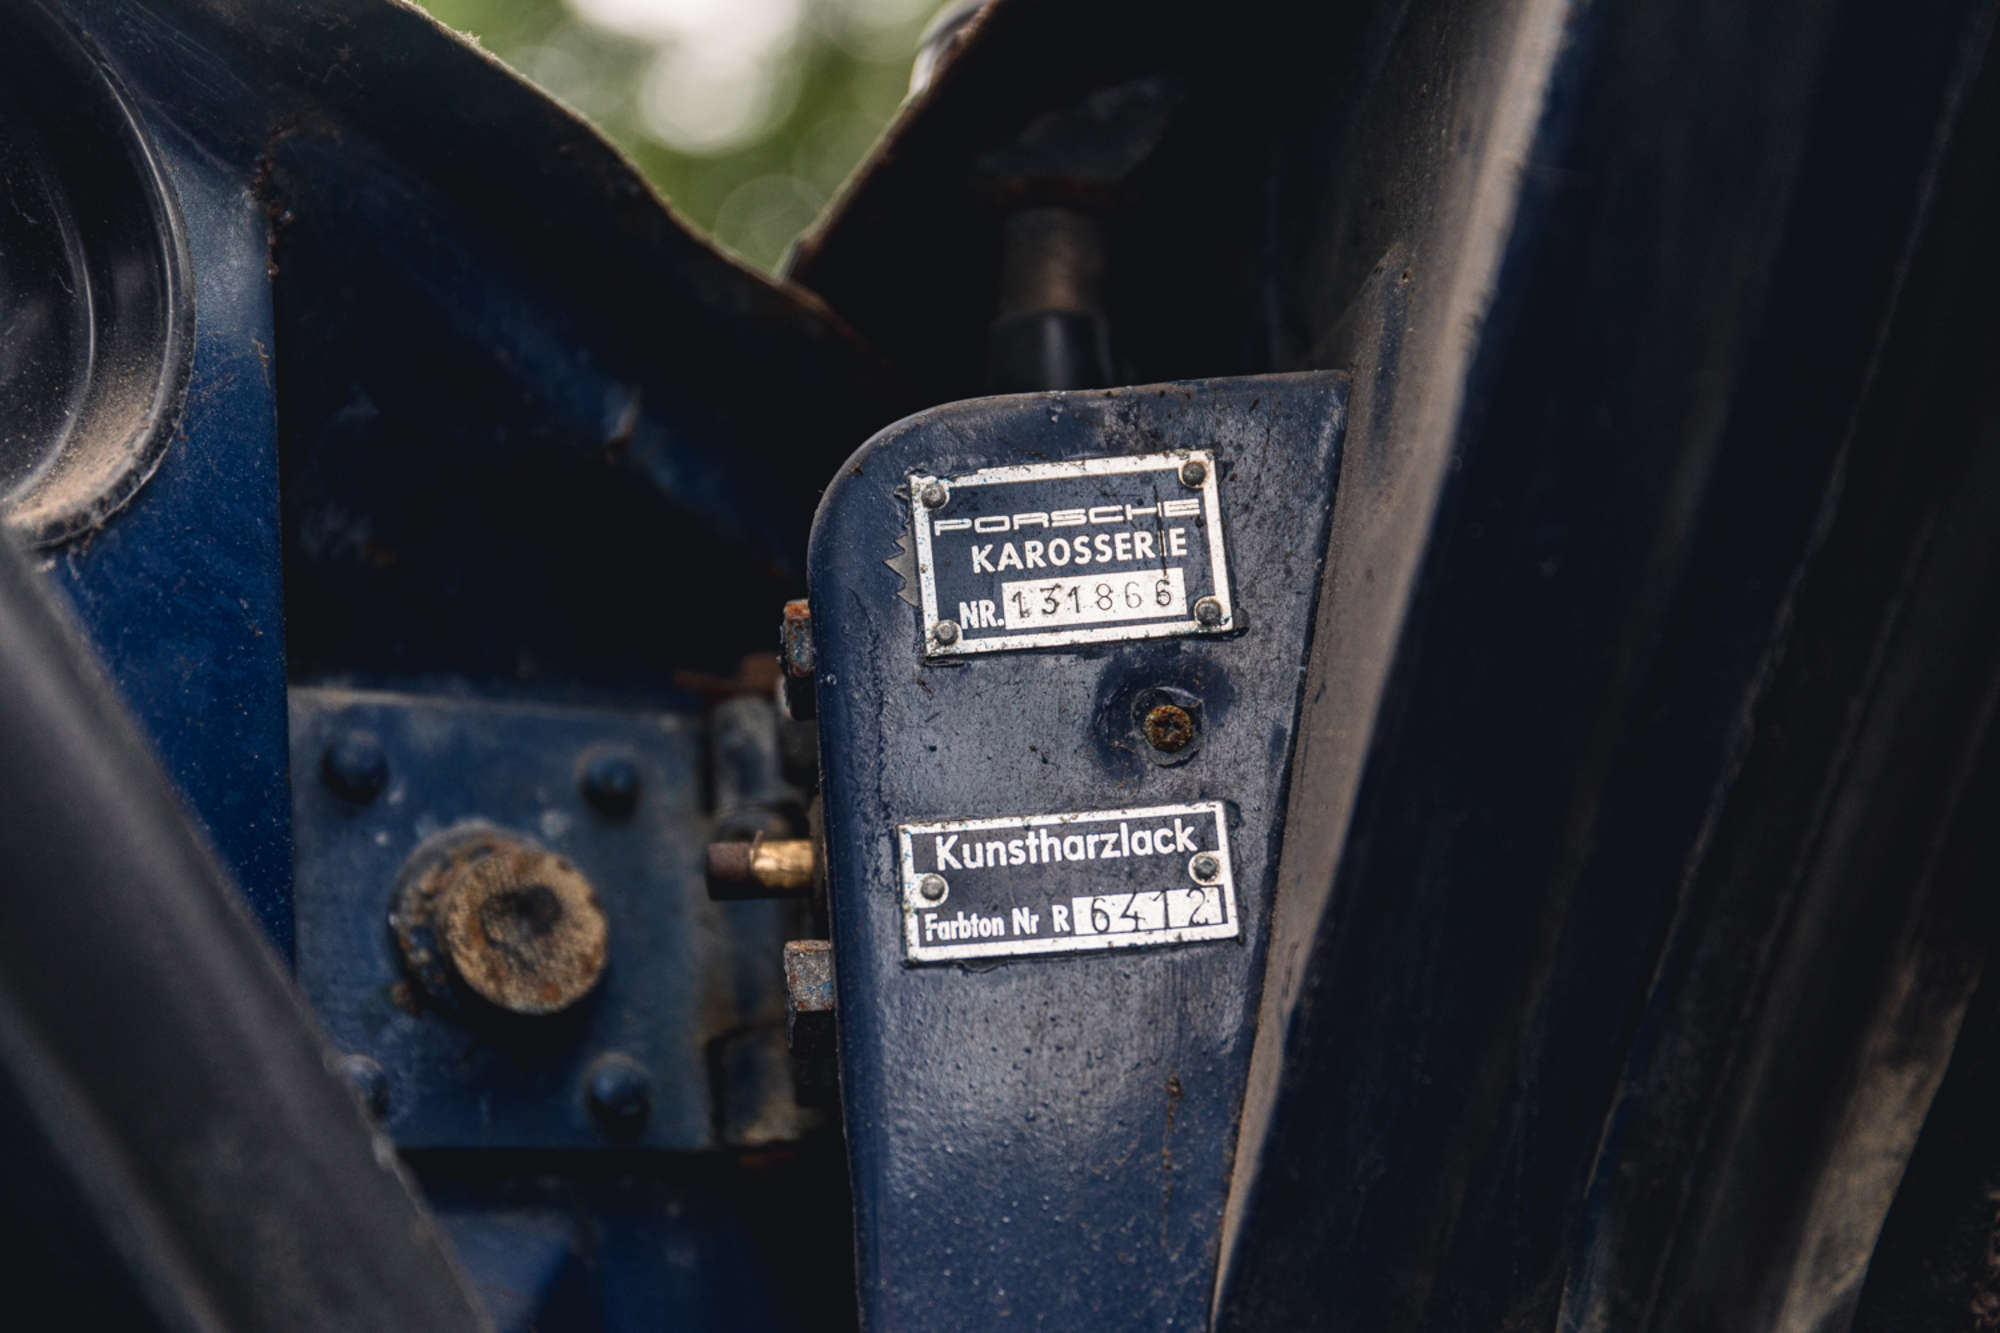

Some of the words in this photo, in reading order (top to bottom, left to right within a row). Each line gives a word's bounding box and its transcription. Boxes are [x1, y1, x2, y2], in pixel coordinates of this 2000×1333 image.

[934, 498, 1200, 537] PORSCHE
[971, 527, 1187, 574] KAROSSERIE
[958, 599, 1005, 630] NR.
[1011, 578, 1173, 619] 131866
[935, 818, 1199, 871] Kunstharzlack
[924, 912, 1005, 942] Farbton
[1010, 907, 1040, 936] Nr
[1052, 904, 1071, 934] R
[1089, 887, 1213, 934] 6412
